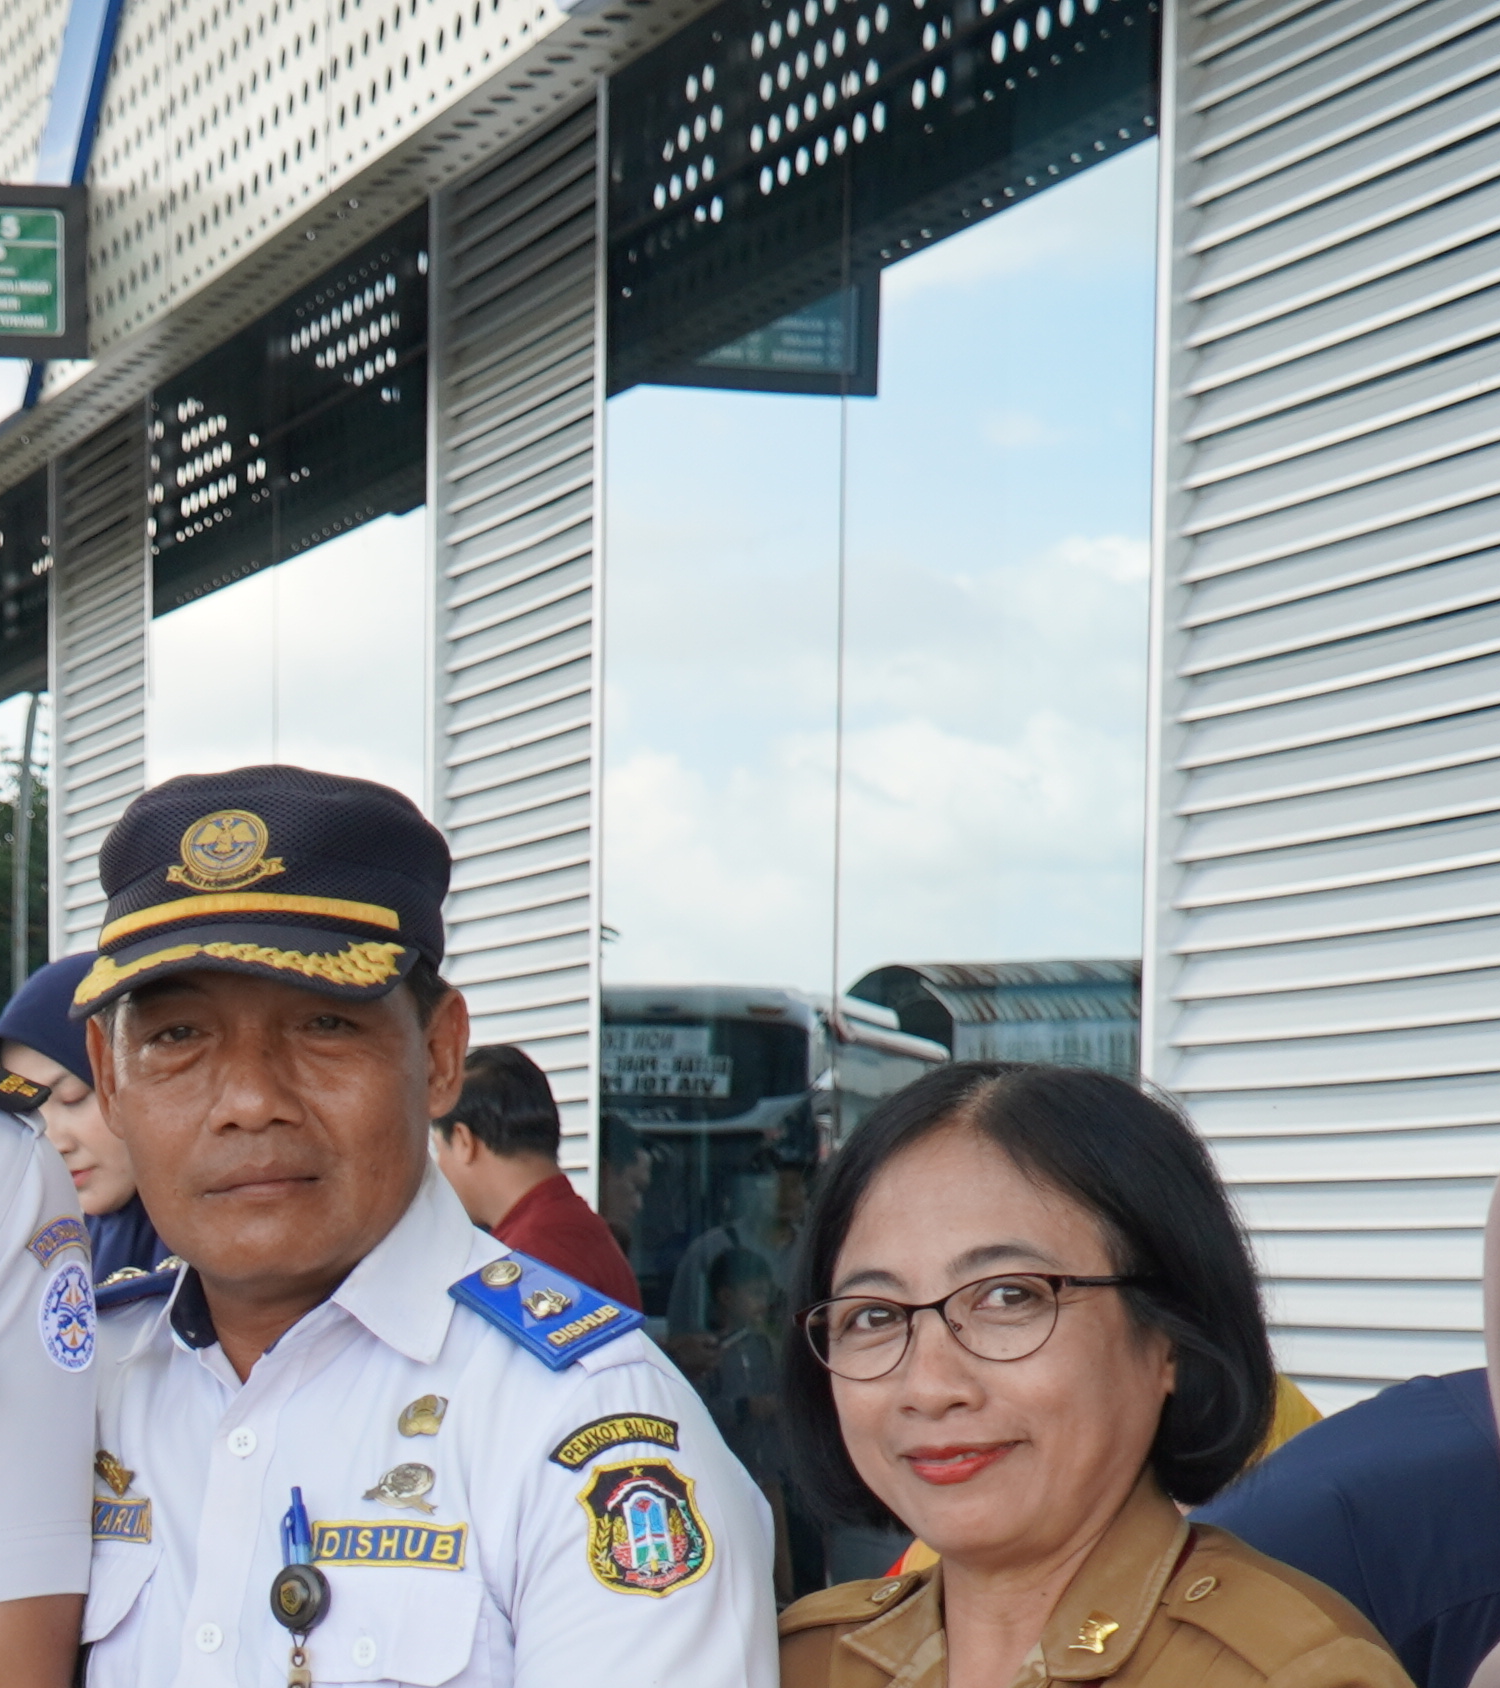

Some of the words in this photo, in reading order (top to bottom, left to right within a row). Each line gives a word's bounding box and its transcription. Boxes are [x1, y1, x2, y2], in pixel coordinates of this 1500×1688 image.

[546, 1303, 620, 1348] DISHUB
[564, 1423, 622, 1463] PEMKOT
[625, 1420, 674, 1440] BLITAR
[323, 1528, 457, 1561] DISHUB
